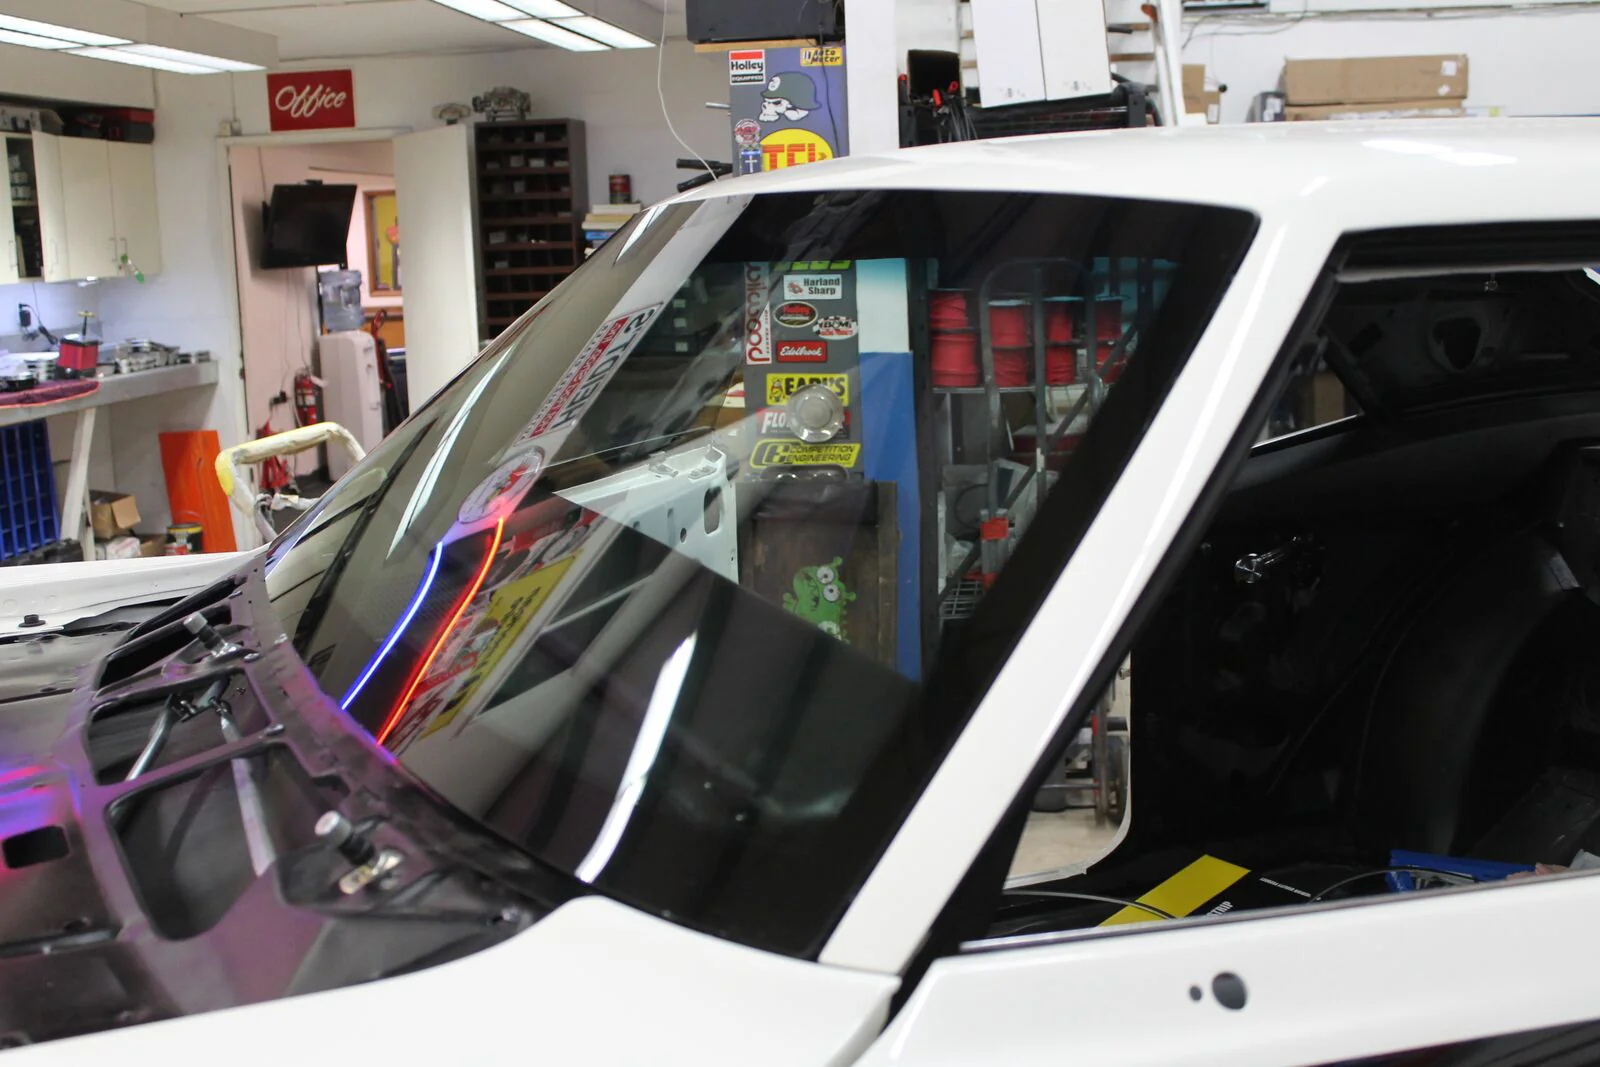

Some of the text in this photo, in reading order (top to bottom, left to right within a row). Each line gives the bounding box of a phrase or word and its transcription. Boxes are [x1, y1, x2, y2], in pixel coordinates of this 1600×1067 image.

[730, 60, 764, 72] Holley
[275, 84, 347, 118] Office
[803, 278, 841, 287] Harland
[808, 287, 836, 296] Sharp
[779, 345, 822, 357] Edelbrock
[787, 445, 854, 454] COMPETITION
[785, 453, 852, 463] ENGINEERING
